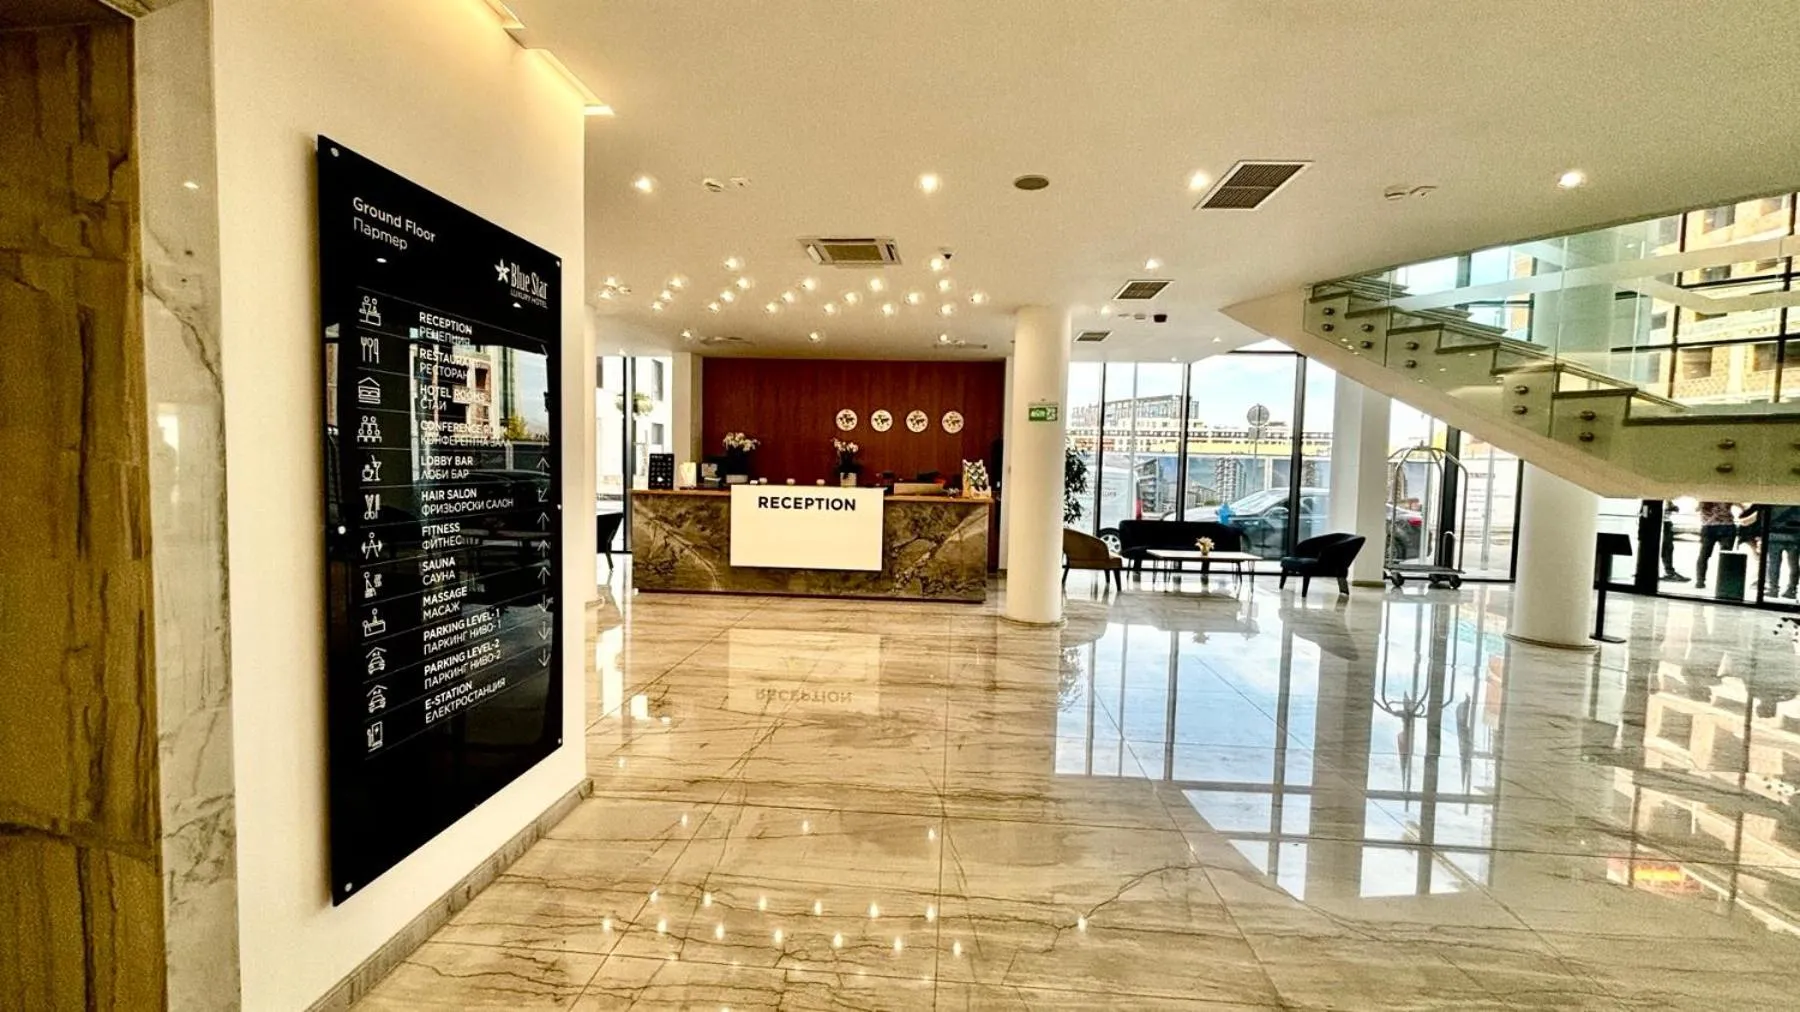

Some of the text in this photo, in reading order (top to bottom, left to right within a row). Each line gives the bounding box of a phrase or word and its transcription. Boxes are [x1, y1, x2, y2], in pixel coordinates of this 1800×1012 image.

[353, 196, 436, 243] Ground Floor
[510, 261, 548, 300] Blue Star
[419, 311, 473, 335] RECEPTION
[420, 384, 452, 399] HOTEL
[421, 455, 474, 466] LOBBY BAR
[421, 469, 470, 480] ЛОБИ БАР
[421, 488, 477, 501] HAIR SALON
[758, 495, 857, 511] RECEPTION
[421, 499, 514, 516] ФРИЗЬОРСКИ САЛОН
[421, 522, 460, 537] FITNESS
[421, 535, 462, 550] ФИТНЕС
[422, 556, 456, 572] SAUNA
[422, 570, 456, 586] САУНА
[422, 586, 468, 607] MASSAGE
[422, 601, 460, 621] МАСАЖ
[423, 619, 465, 642] PARKING
[423, 619, 501, 655] ПАРКИНГ НИВО-1
[424, 638, 500, 676] PARKING LEVEL-2
[424, 650, 501, 690] ПАРКИНГ НИВО-2
[425, 681, 473, 711] E-STATION
[425, 678, 506, 724] ЕЛЕКТРОСТАНЦИЯ
